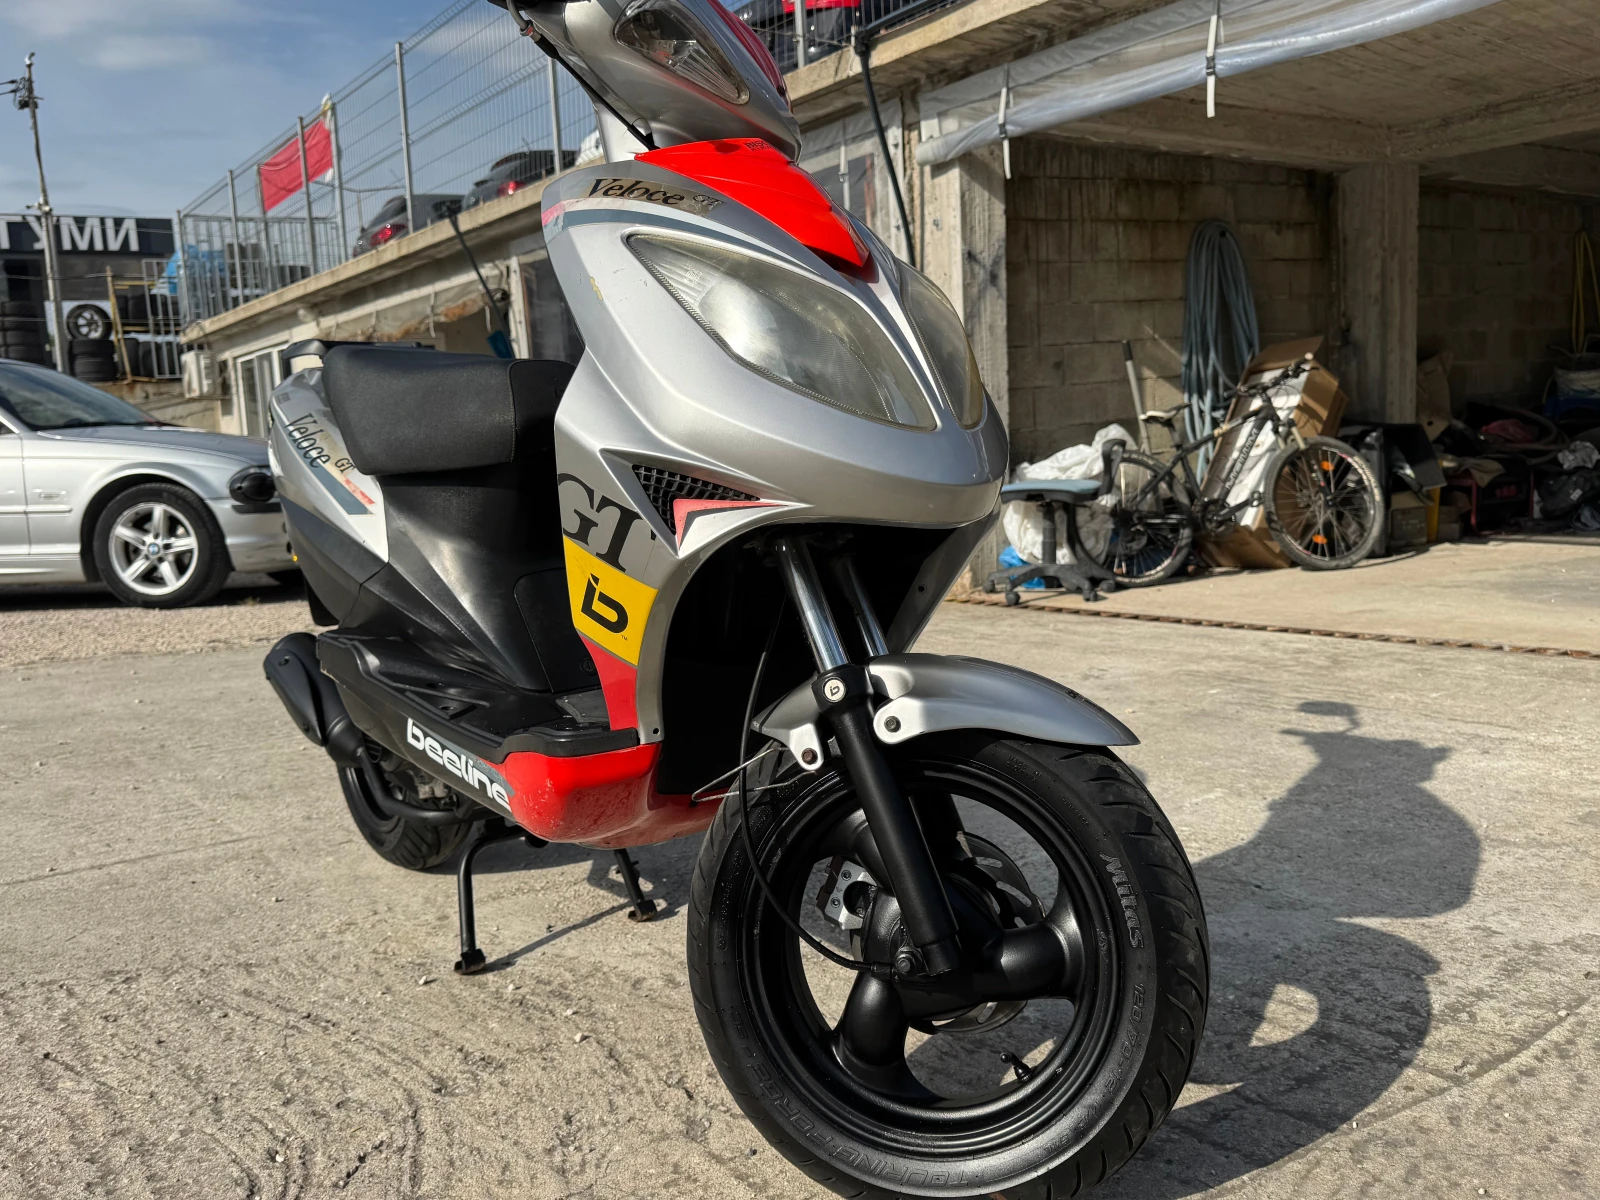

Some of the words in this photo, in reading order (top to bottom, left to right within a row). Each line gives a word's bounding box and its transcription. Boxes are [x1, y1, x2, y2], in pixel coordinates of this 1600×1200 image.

[588, 179, 685, 205] Veloce
[0, 215, 140, 252] ГУМИ
[284, 412, 331, 468] Veloce
[334, 457, 356, 474] GT
[557, 472, 657, 573] GT
[406, 717, 513, 813] beeline
[832, 1144, 969, 1188] TOURING
